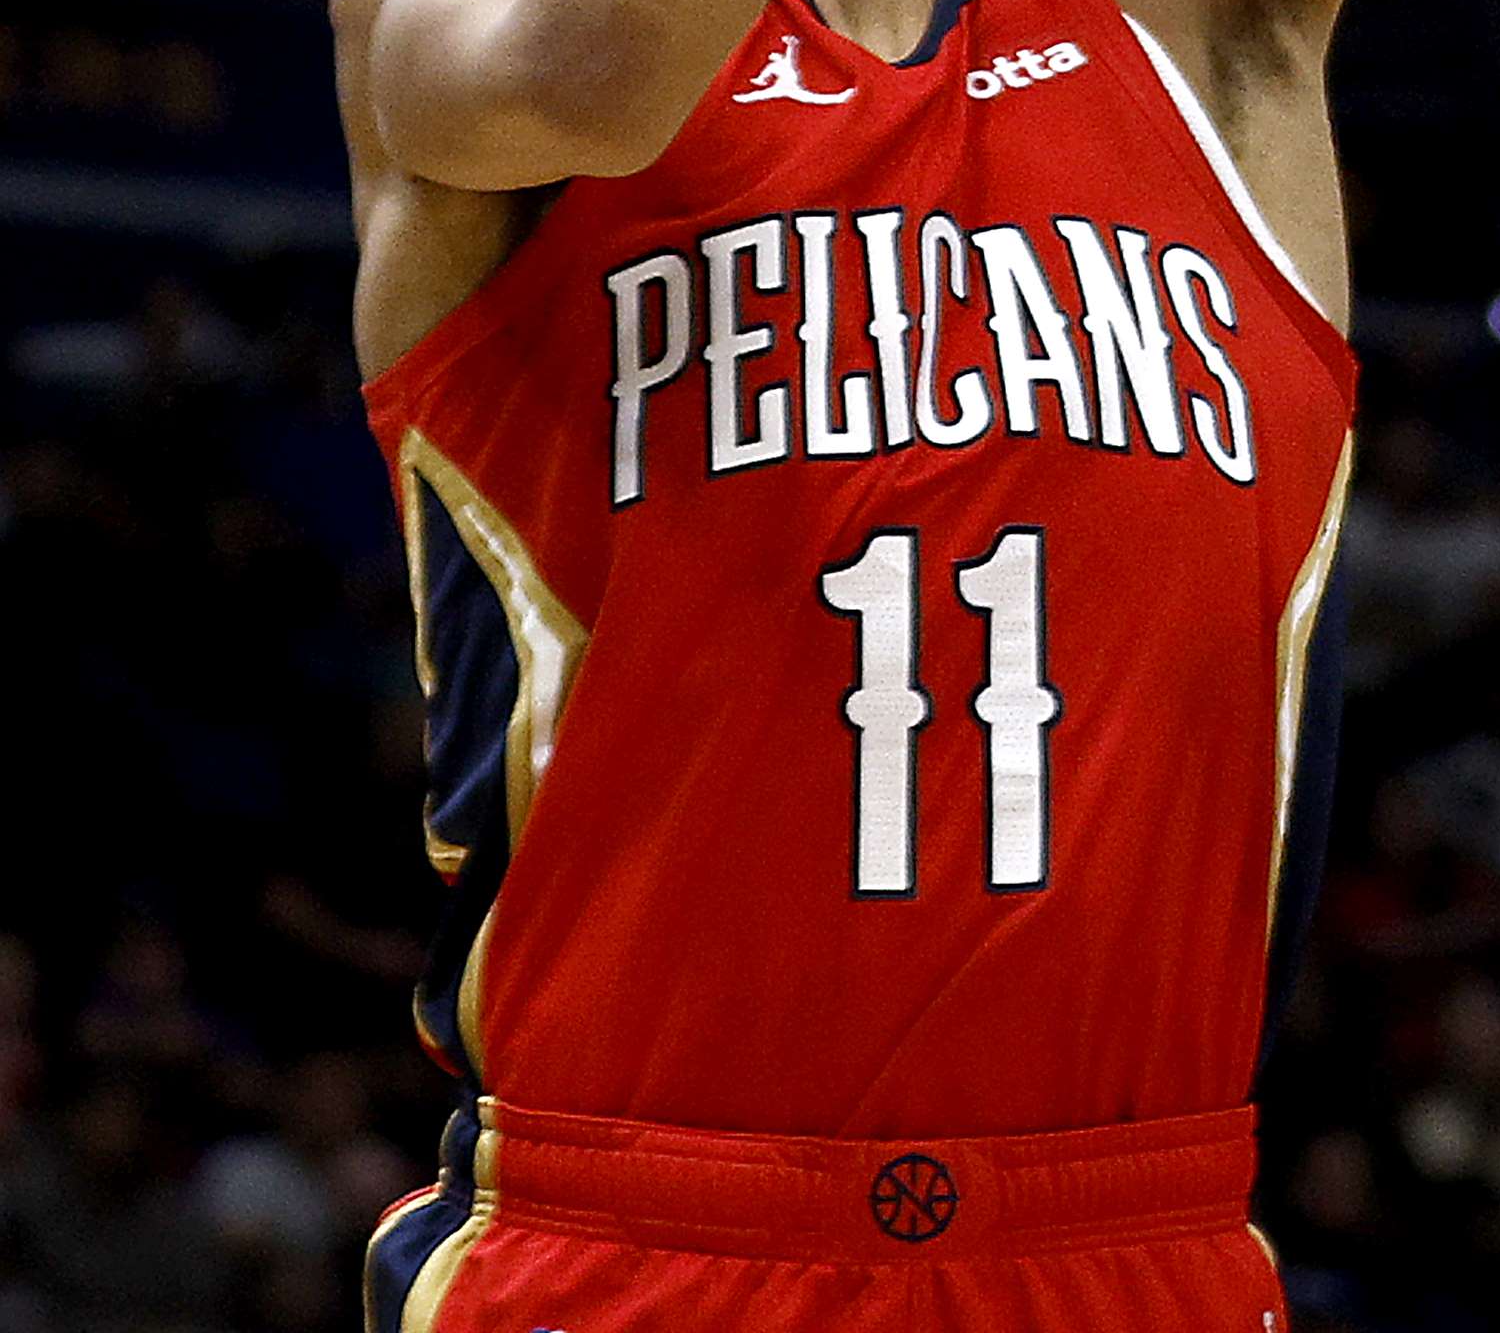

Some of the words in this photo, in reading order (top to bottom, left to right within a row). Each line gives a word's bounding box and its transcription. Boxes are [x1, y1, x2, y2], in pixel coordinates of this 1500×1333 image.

[966, 41, 1088, 100] otta
[606, 204, 1259, 511] PELICANS
[815, 523, 1067, 899] 11
